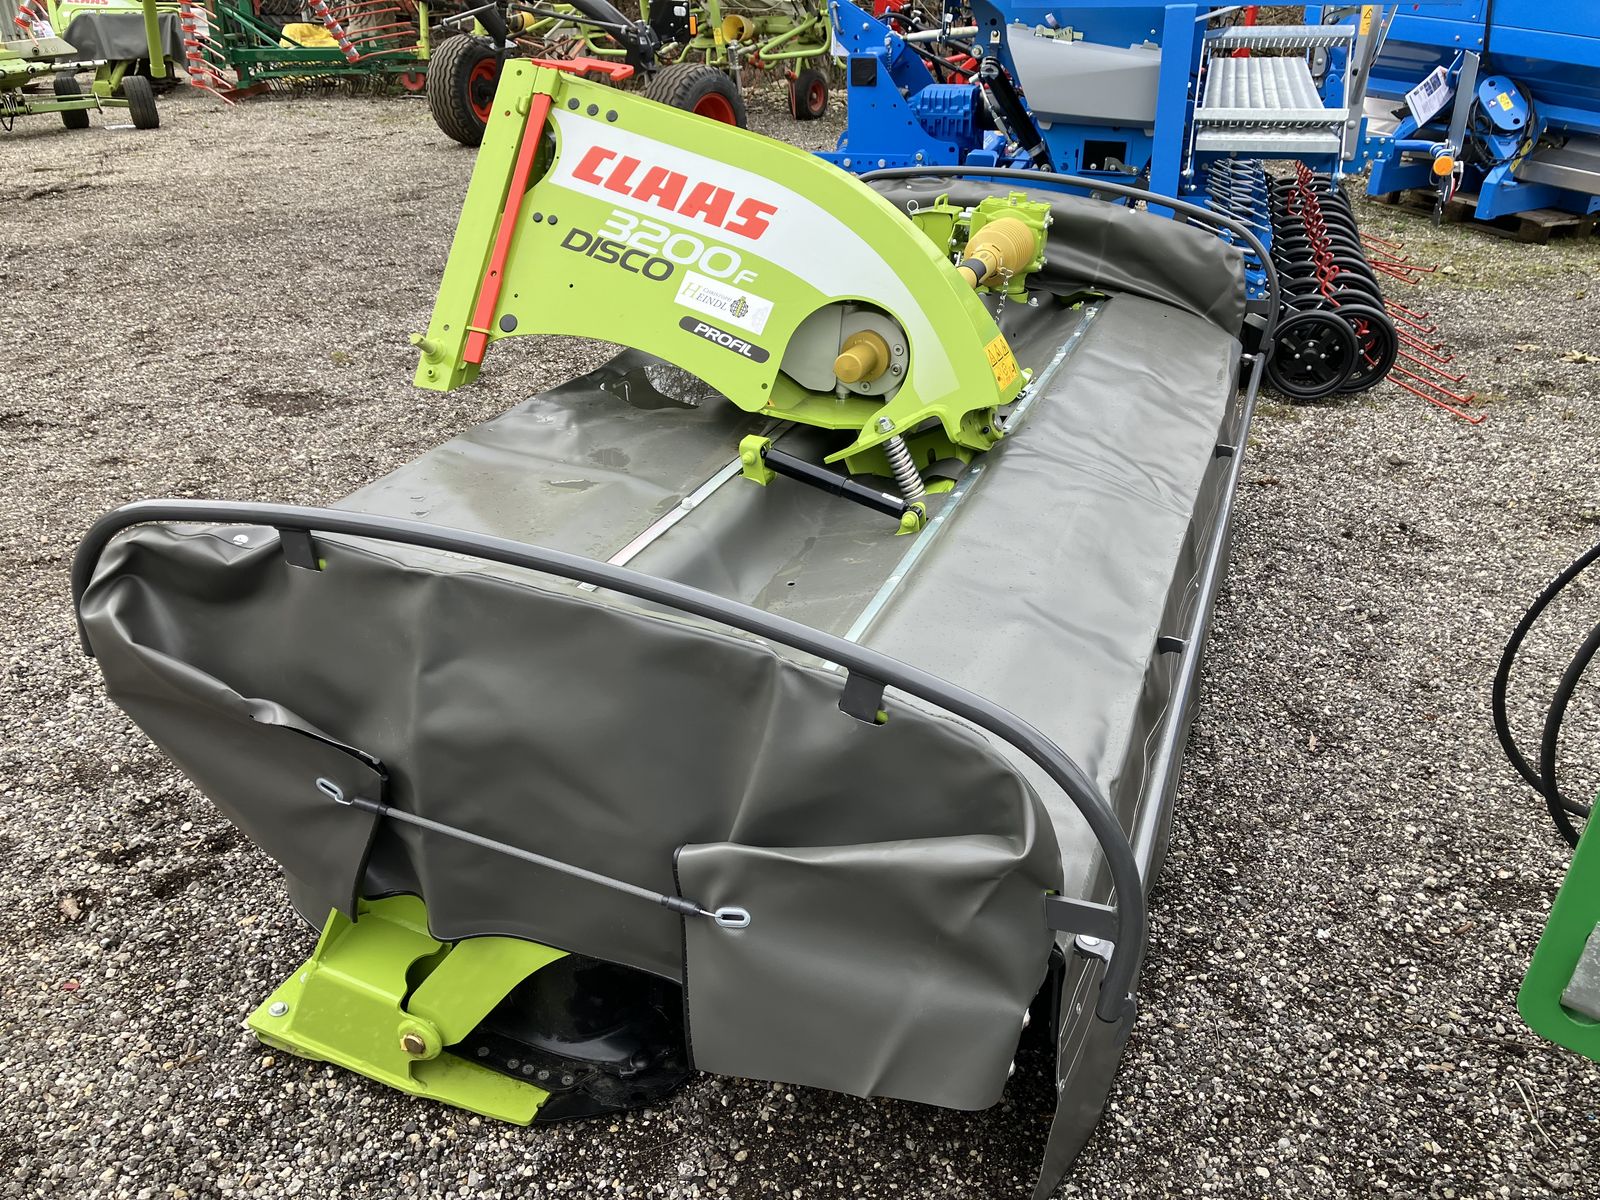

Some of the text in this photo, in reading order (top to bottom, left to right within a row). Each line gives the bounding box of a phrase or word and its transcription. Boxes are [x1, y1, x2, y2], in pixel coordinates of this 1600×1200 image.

[571, 145, 779, 240] CLAAS
[560, 227, 675, 282] DISCO
[680, 282, 728, 311] HEINDL
[693, 322, 752, 357] PROFIL
